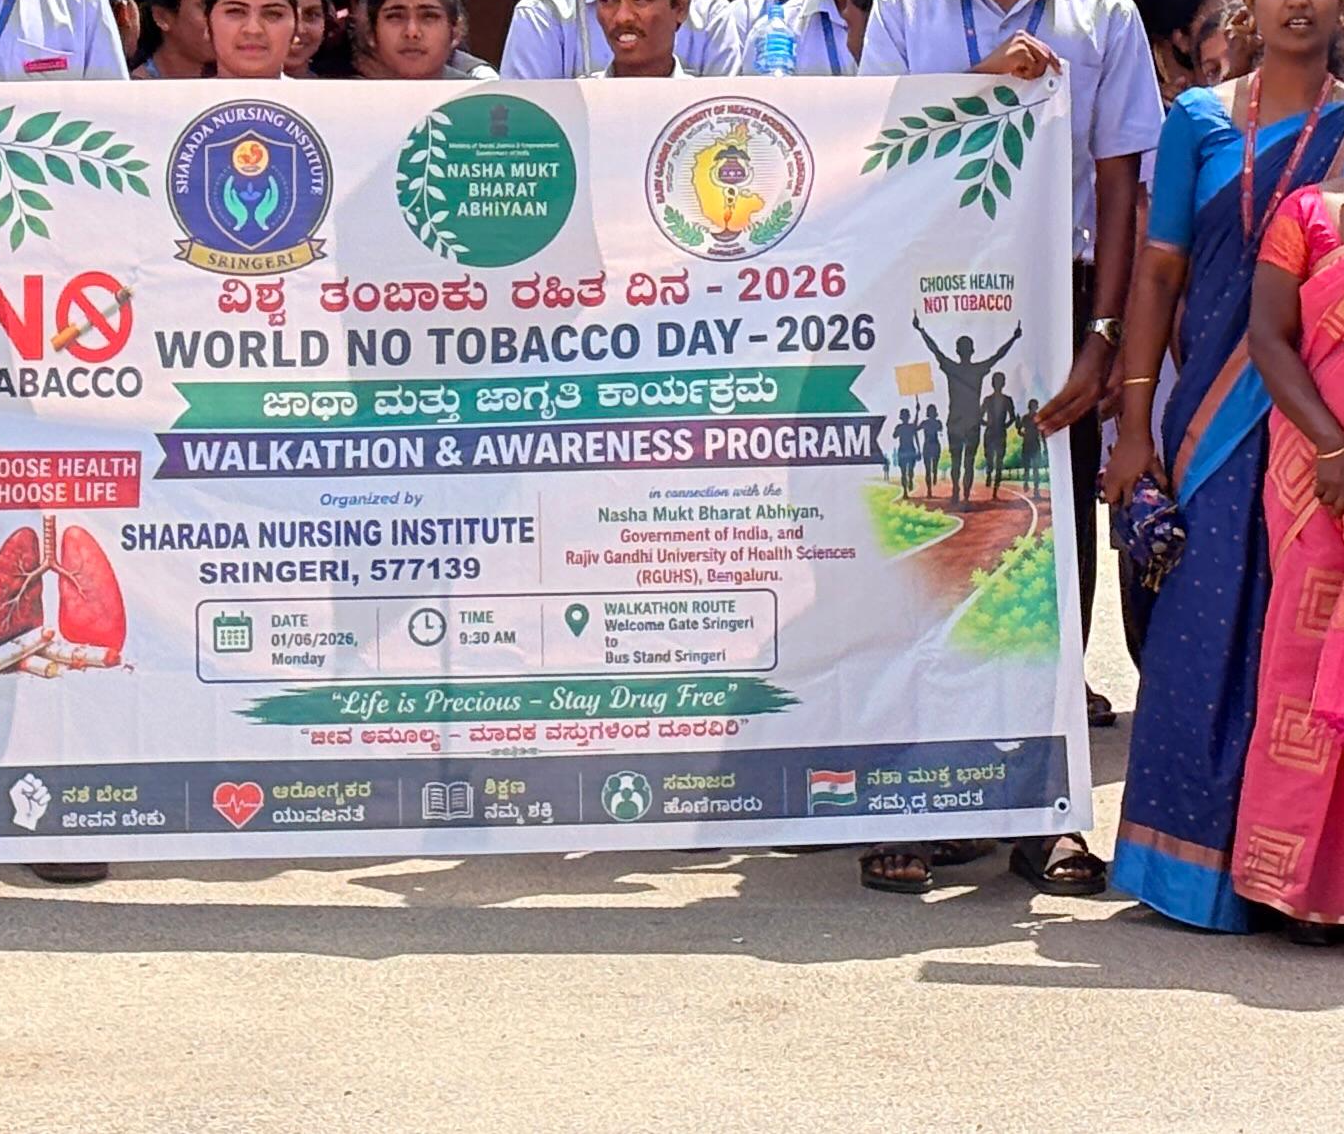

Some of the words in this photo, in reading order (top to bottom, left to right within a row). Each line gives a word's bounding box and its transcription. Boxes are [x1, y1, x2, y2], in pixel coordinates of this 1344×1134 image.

[176, 123, 215, 194] SHARADA
[211, 107, 287, 130] NURSING
[285, 121, 325, 196] INSTITUTE
[446, 163, 505, 178] NASHA
[510, 162, 560, 178] MUKT
[468, 182, 537, 197] BHARAT
[208, 252, 298, 270] SRINGERI
[920, 275, 966, 292] CHOOSE
[970, 273, 1014, 290] HEALTH
[218, 277, 286, 327] ವಿಶ್ವ
[320, 273, 488, 312] ತಂಬಾಕು
[511, 270, 606, 309] ರಹಿತ
[626, 268, 689, 306] ದಿನ
[738, 262, 846, 302] 2026
[924, 295, 949, 313] NOT
[953, 294, 1012, 311] TOBACCO
[156, 330, 329, 369] WORLD
[347, 328, 411, 366] NO
[427, 323, 640, 365] TOBACCO
[263, 389, 357, 421] ಜಾಥಾ
[373, 384, 461, 423] ಮತ್ತು
[476, 381, 582, 420] ಜಾಗೃತಿ
[597, 372, 778, 414] ಕಾರ್ಯಕ್ರಮ
[183, 437, 424, 472] WALKATHON
[435, 436, 462, 466] &
[471, 428, 693, 466] AWARENESS
[705, 424, 871, 460] PROGRAM
[58, 457, 137, 478] HEALTH
[74, 482, 117, 502] LIFE
[320, 492, 400, 509] Organized
[404, 491, 423, 509] by
[649, 487, 661, 499] in
[665, 486, 729, 499] connection
[733, 484, 760, 497] with
[763, 484, 782, 497] the
[598, 508, 647, 522] Nasha
[653, 507, 694, 521] Mukt
[699, 506, 752, 521] Bharat
[756, 505, 825, 522] Abhiyan,
[120, 522, 249, 551] SHARADA
[259, 519, 381, 548] NURSING
[391, 517, 534, 546] INSTITUTE
[620, 528, 710, 543] Government
[714, 527, 729, 540] of
[733, 527, 773, 541] India,
[777, 525, 803, 539] and
[566, 550, 599, 566] Rajiv
[604, 549, 653, 564] Gandhi
[657, 547, 726, 564] University
[730, 547, 745, 561] of
[748, 546, 793, 560] Health
[797, 545, 856, 559] Sciences
[198, 560, 359, 586] SRINGERI,
[370, 557, 481, 581] 577139
[636, 569, 703, 586] (RGUHS),
[707, 567, 782, 584] Bengaluru.
[459, 610, 494, 624] TIME
[604, 601, 688, 615] WALKATHON
[692, 600, 736, 613] ROUTE
[271, 614, 309, 628] DATE
[605, 618, 664, 632] Welcome
[668, 617, 699, 631] Gate
[703, 616, 754, 633] Sringeri
[271, 632, 358, 648] 01/06/2026,
[459, 631, 490, 645] 9:30
[493, 631, 516, 644] AM
[605, 635, 618, 648] to
[271, 652, 325, 667] Monday
[606, 651, 629, 664] Bus
[633, 650, 671, 664] Stand
[675, 649, 726, 664] Sringeri
[397, 692, 416, 714] is
[424, 689, 521, 713] Precious
[549, 686, 601, 716] Stay
[609, 685, 668, 715] Drug
[469, 722, 537, 743] ಮಾದಕ
[545, 720, 650, 747] ವಸ್ತುಗಳಿಂದ
[663, 772, 736, 790] ಸಮಾಜದ
[957, 763, 1006, 785] ಭಾರತ
[272, 780, 372, 806] ಆರೋಗ್ಯಕರ
[933, 788, 984, 810] ಭಾರತ
